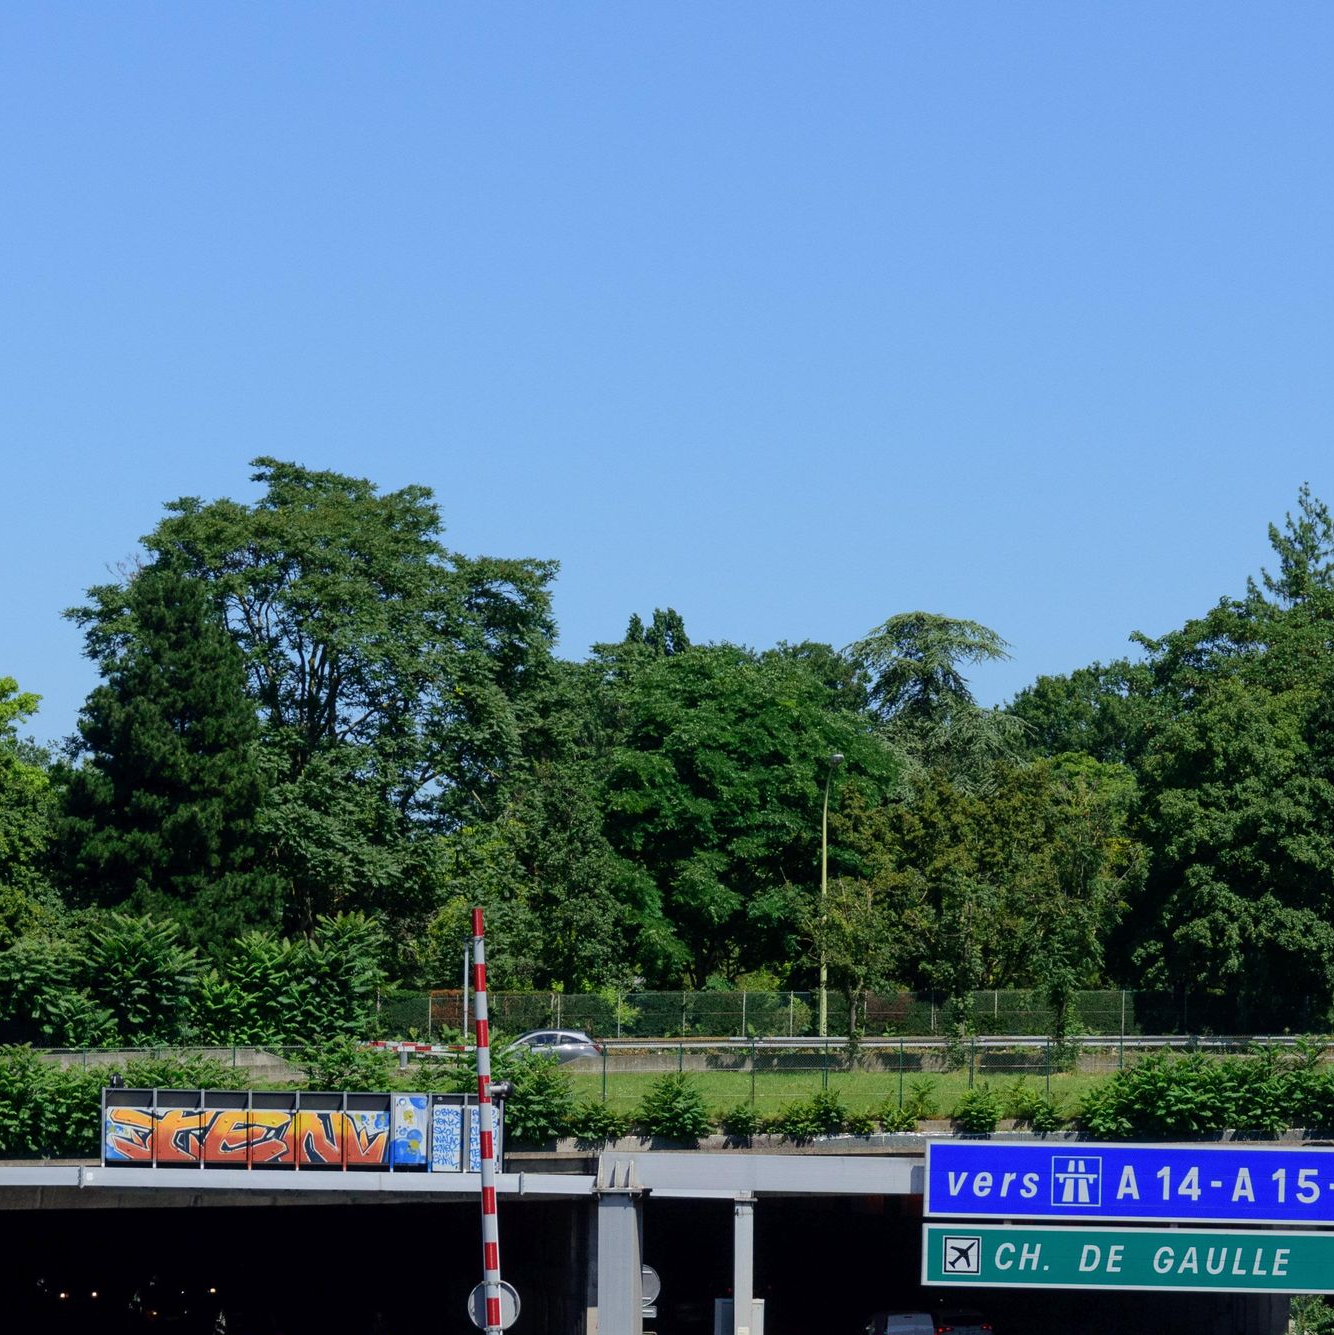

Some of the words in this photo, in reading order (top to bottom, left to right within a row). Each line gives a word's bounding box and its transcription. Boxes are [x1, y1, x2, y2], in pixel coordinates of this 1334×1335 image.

[947, 1170, 1039, 1199] vers
[994, 1242, 1050, 1272] CH.
[1079, 1244, 1125, 1273] DE
[1152, 1246, 1292, 1277] GAULLE
